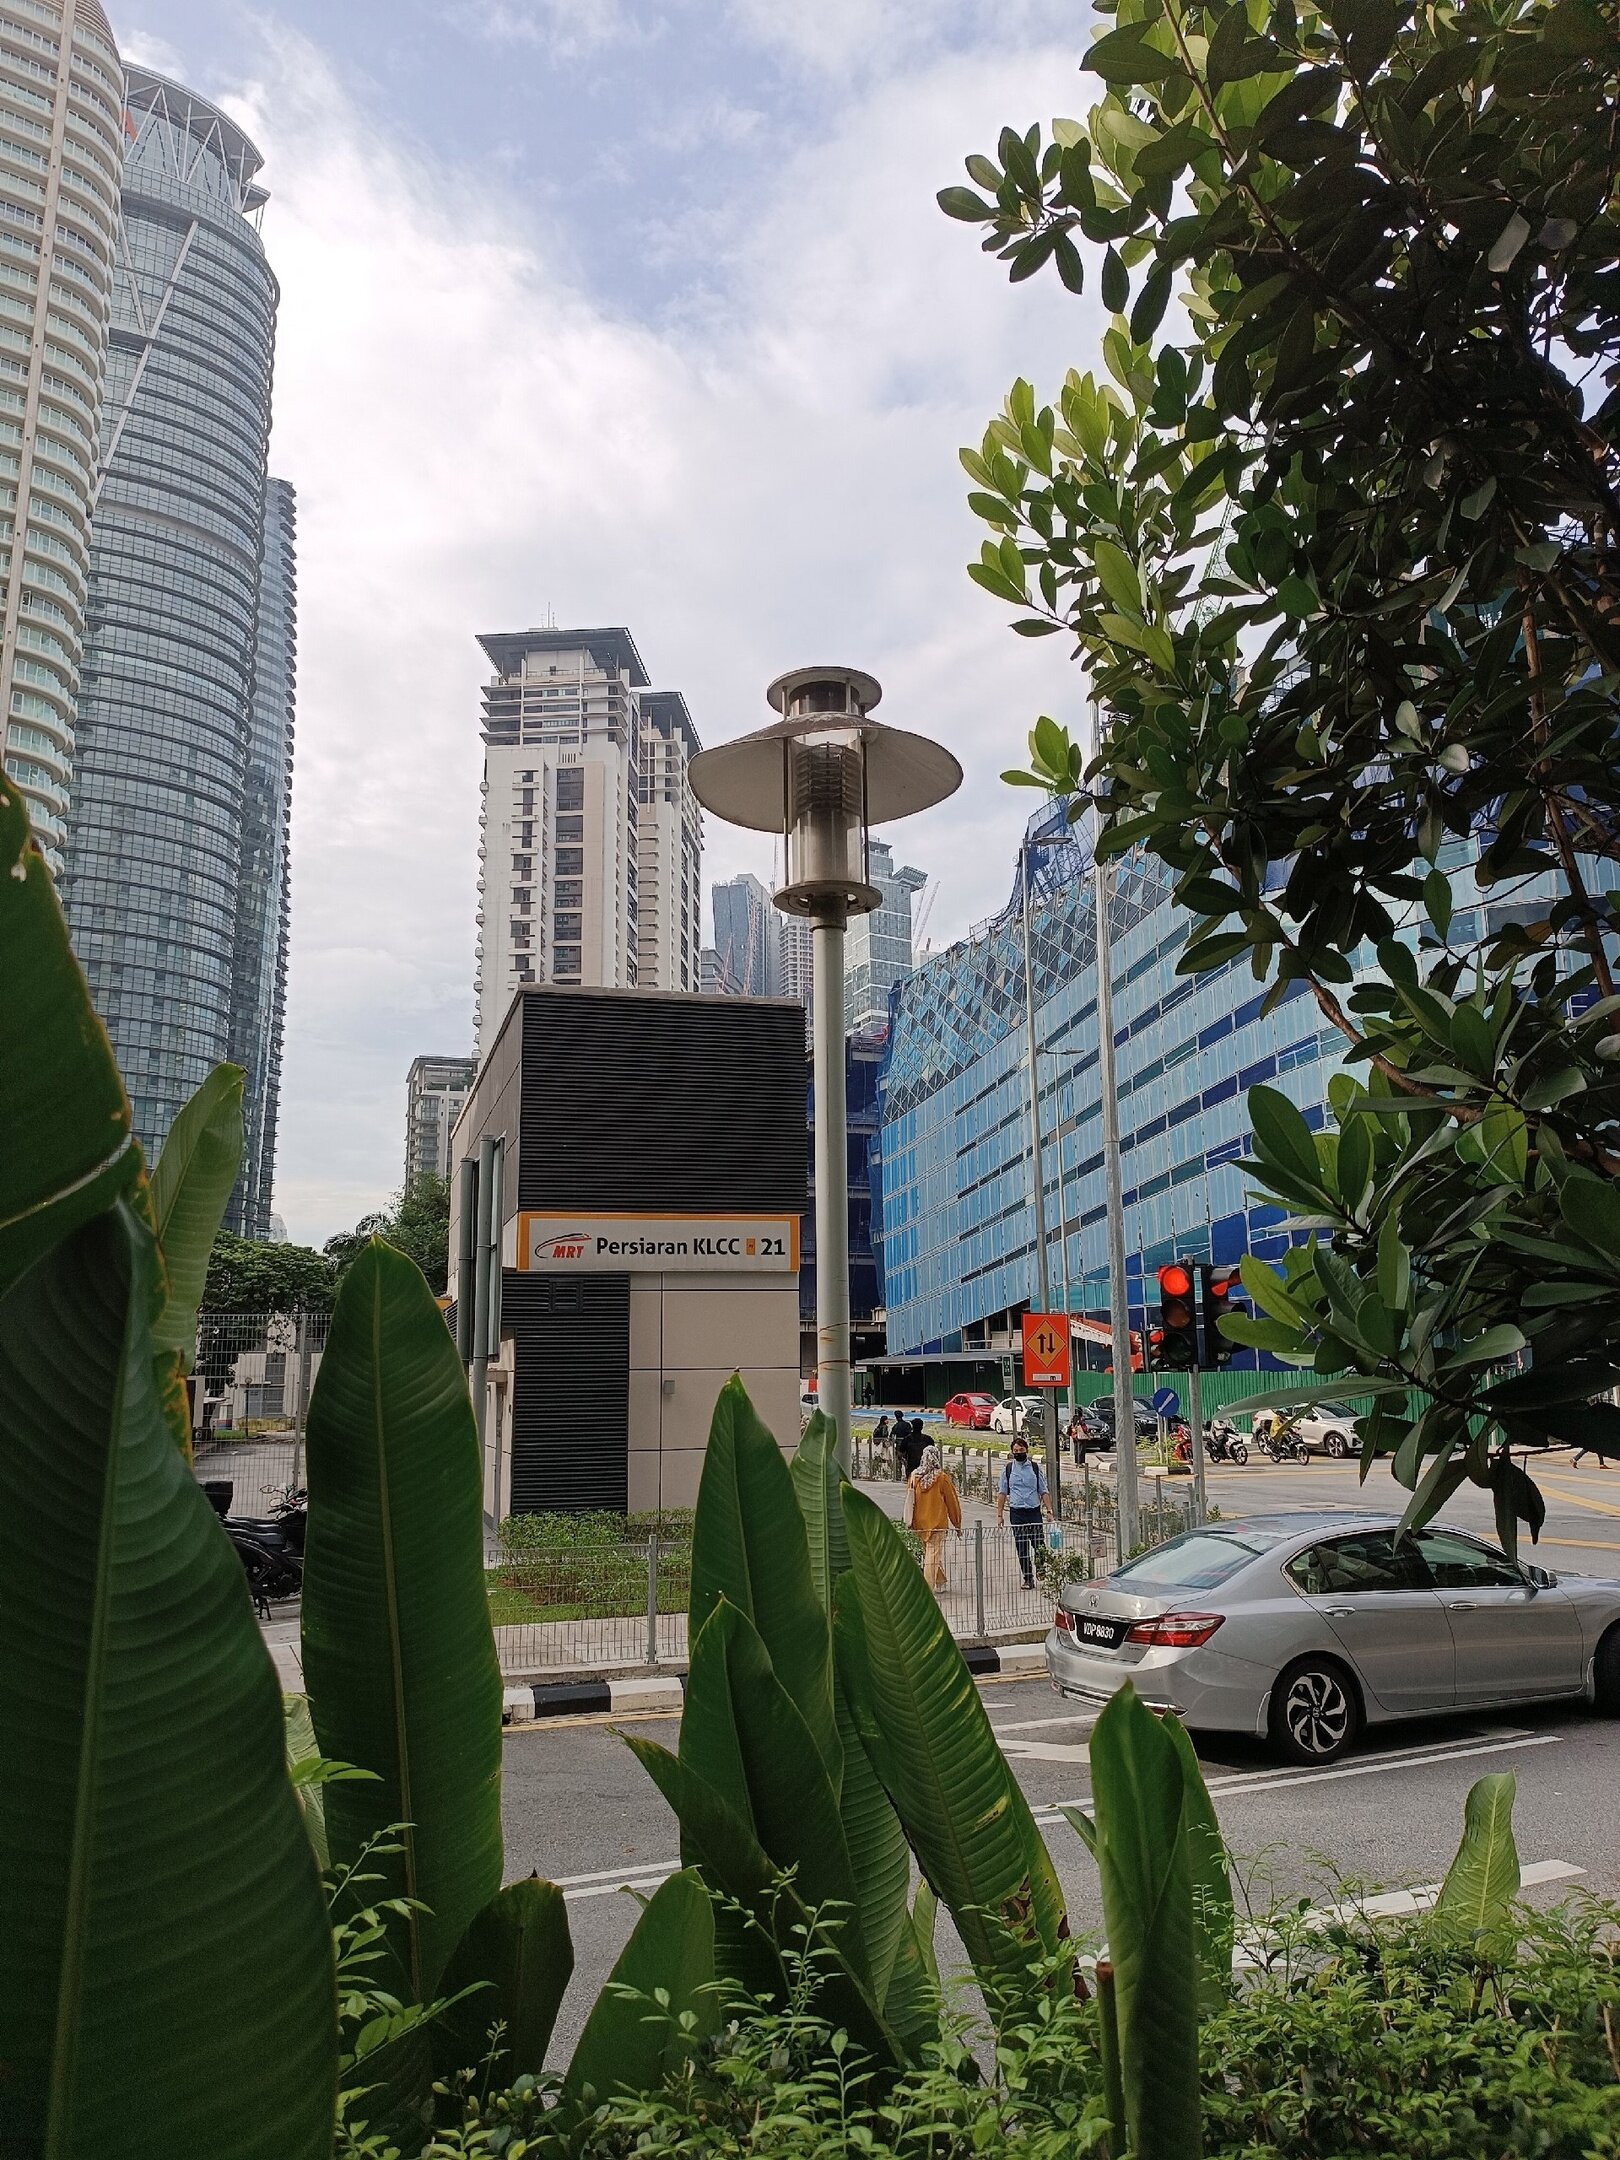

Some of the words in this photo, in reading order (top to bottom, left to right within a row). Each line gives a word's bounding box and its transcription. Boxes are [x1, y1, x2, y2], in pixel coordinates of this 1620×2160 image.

[552, 1245, 584, 1258] MRT
[596, 1237, 688, 1255] Persiaran
[693, 1238, 740, 1255] KLCC
[760, 1238, 786, 1255] 21
